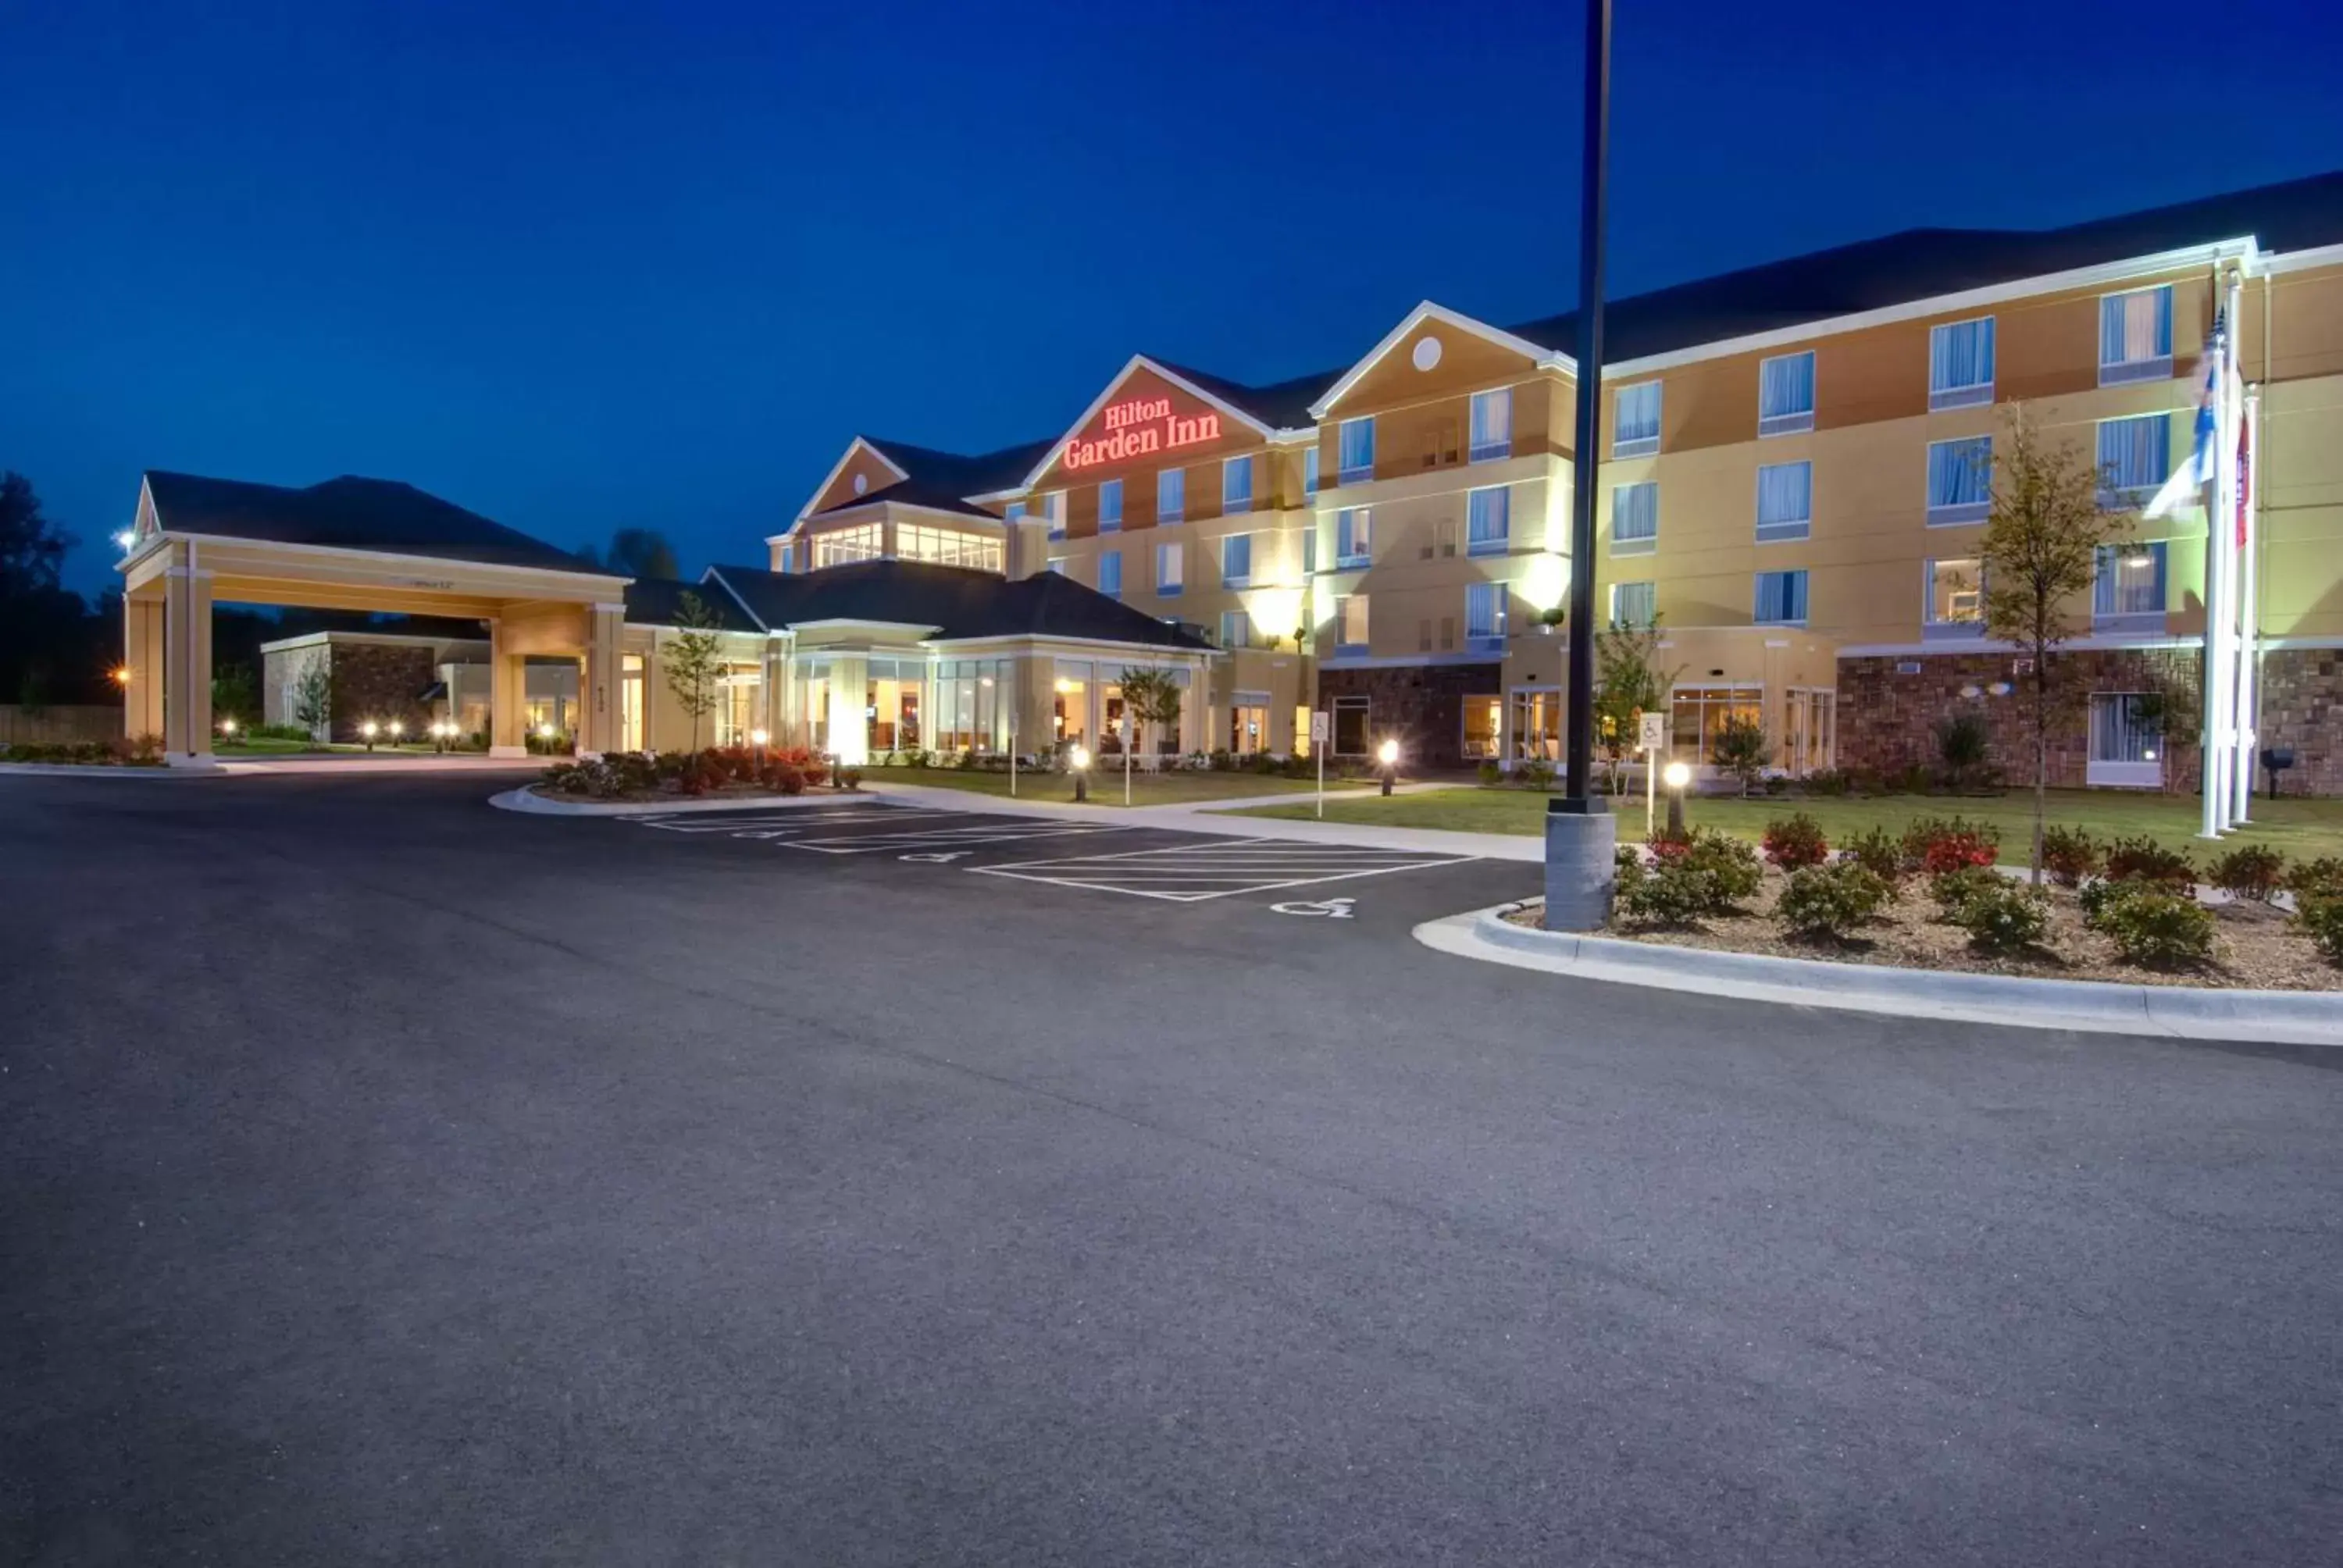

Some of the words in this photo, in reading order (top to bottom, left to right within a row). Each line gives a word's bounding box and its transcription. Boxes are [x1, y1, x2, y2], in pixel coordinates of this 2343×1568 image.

[1105, 399, 1170, 429] Hilton
[1064, 428, 1159, 469] Garden
[1166, 414, 1221, 448] Inn
